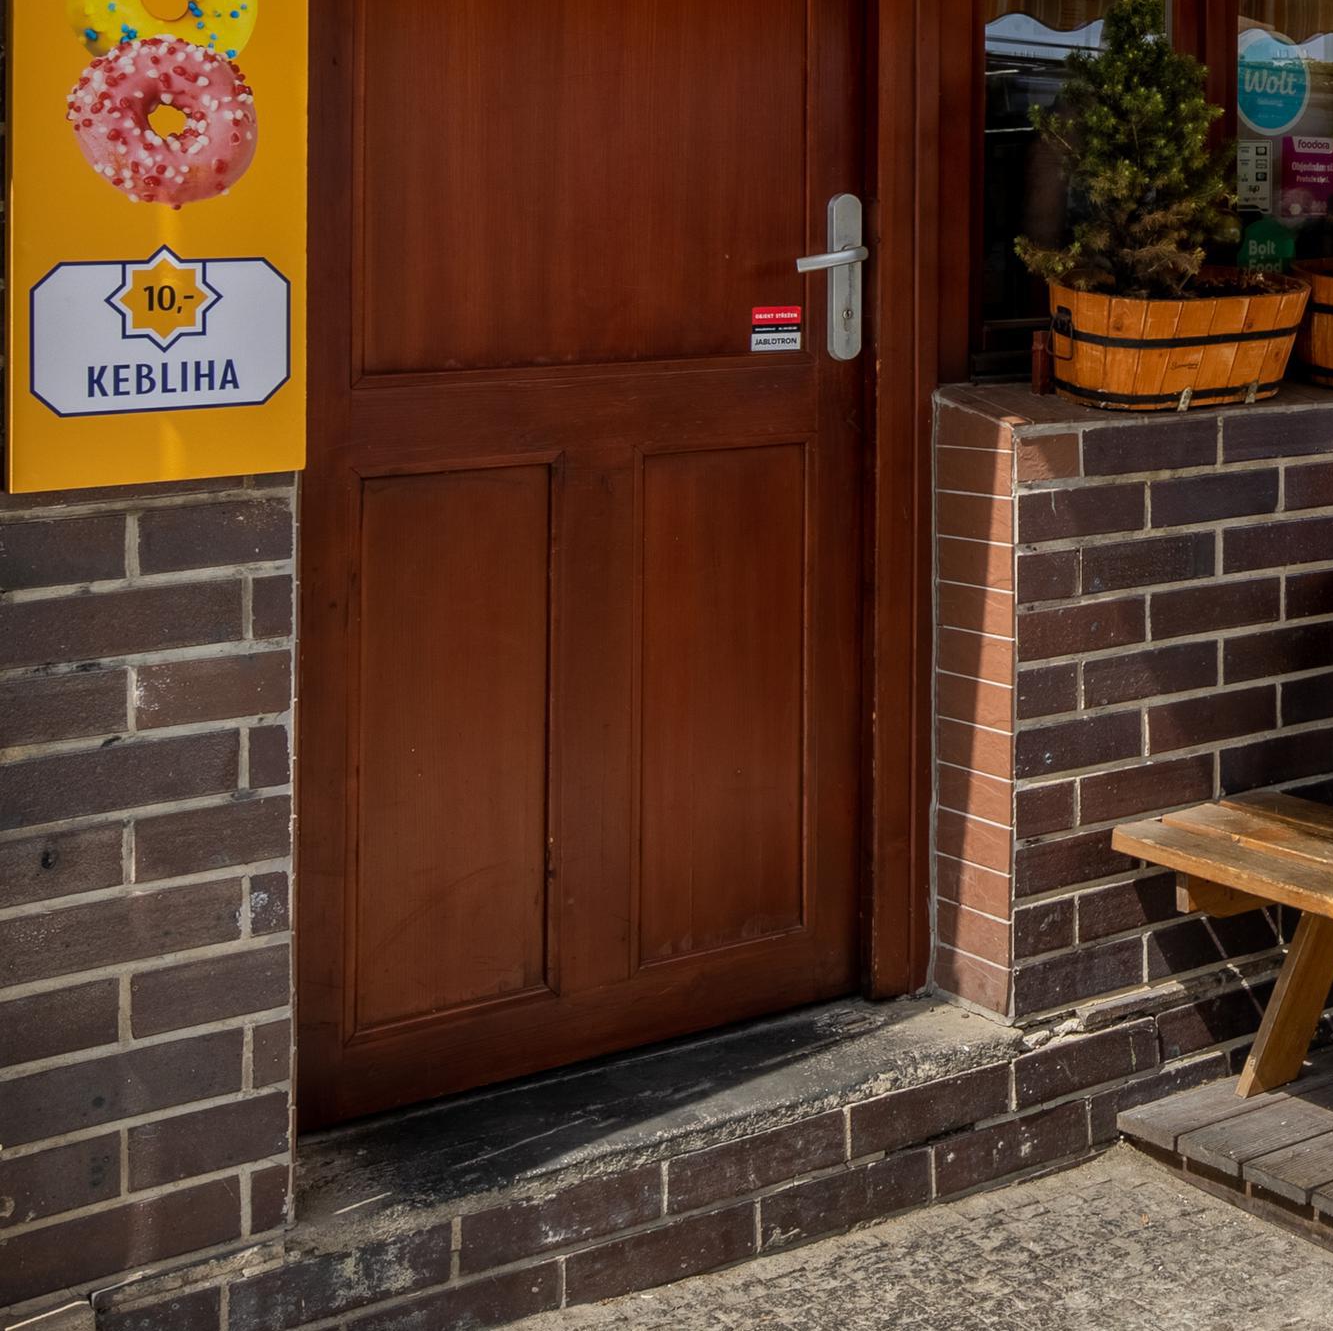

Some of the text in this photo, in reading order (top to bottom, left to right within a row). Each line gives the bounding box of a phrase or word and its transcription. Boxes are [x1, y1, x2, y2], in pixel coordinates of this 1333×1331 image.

[1243, 68, 1298, 95] Wolt
[1297, 138, 1330, 150] foodora
[1248, 239, 1276, 256] Bolt
[142, 285, 195, 315] 10,-
[755, 337, 797, 346] JABLOTRON
[87, 358, 240, 398] KEBLIHA
